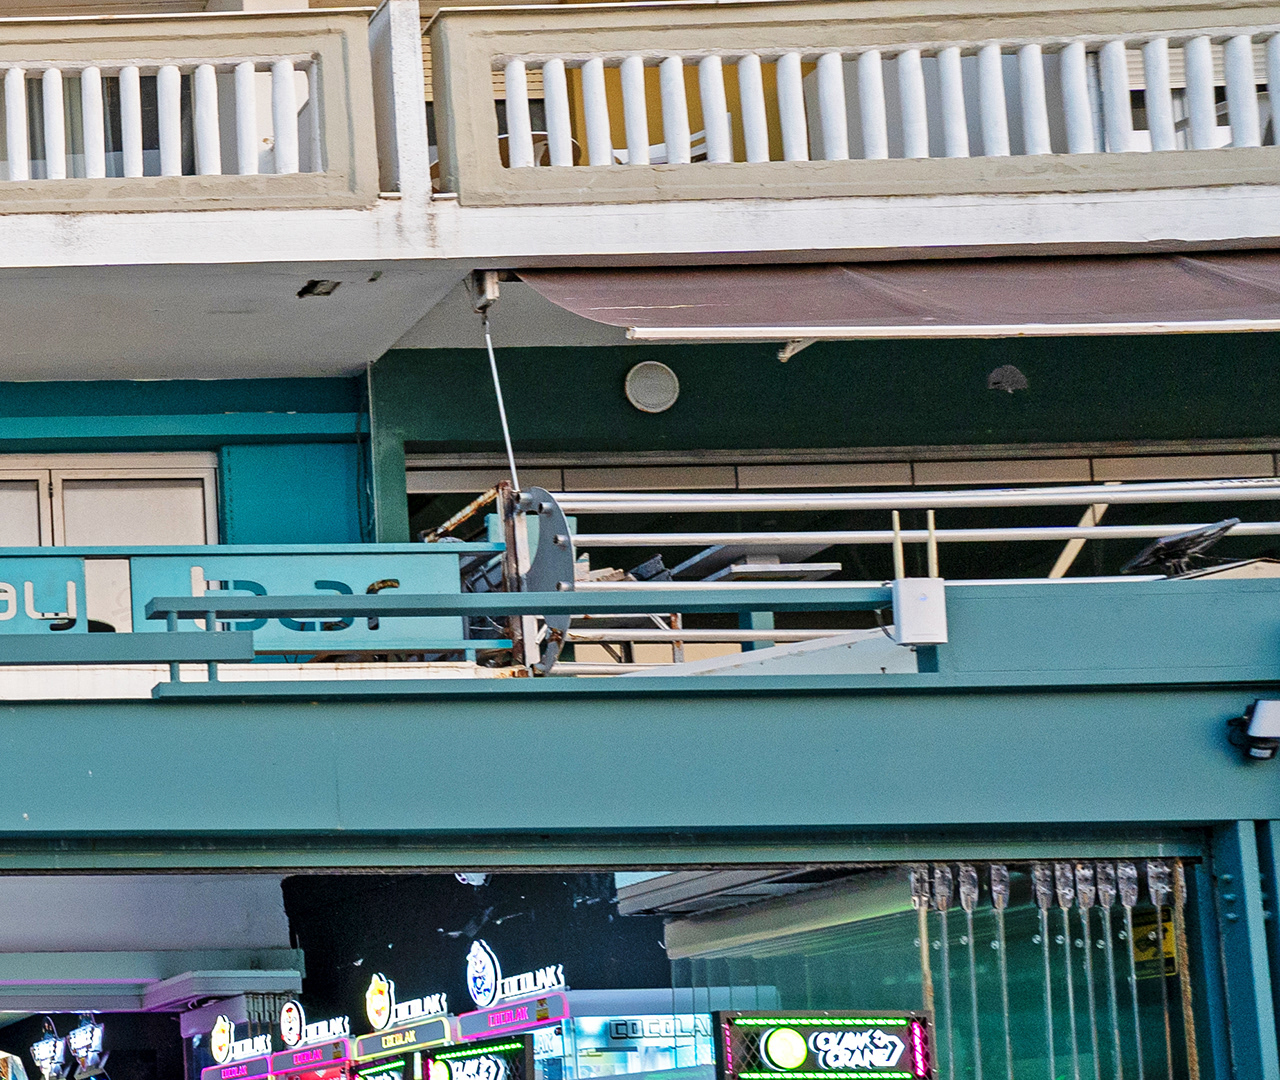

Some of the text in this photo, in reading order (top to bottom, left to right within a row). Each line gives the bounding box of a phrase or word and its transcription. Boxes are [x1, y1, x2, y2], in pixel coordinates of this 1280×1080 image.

[488, 1007, 529, 1027] COCOLAK
[608, 1018, 712, 1040] COCOLA
[381, 1030, 416, 1048] COCOLAK
[293, 1048, 323, 1065] COCOLAK
